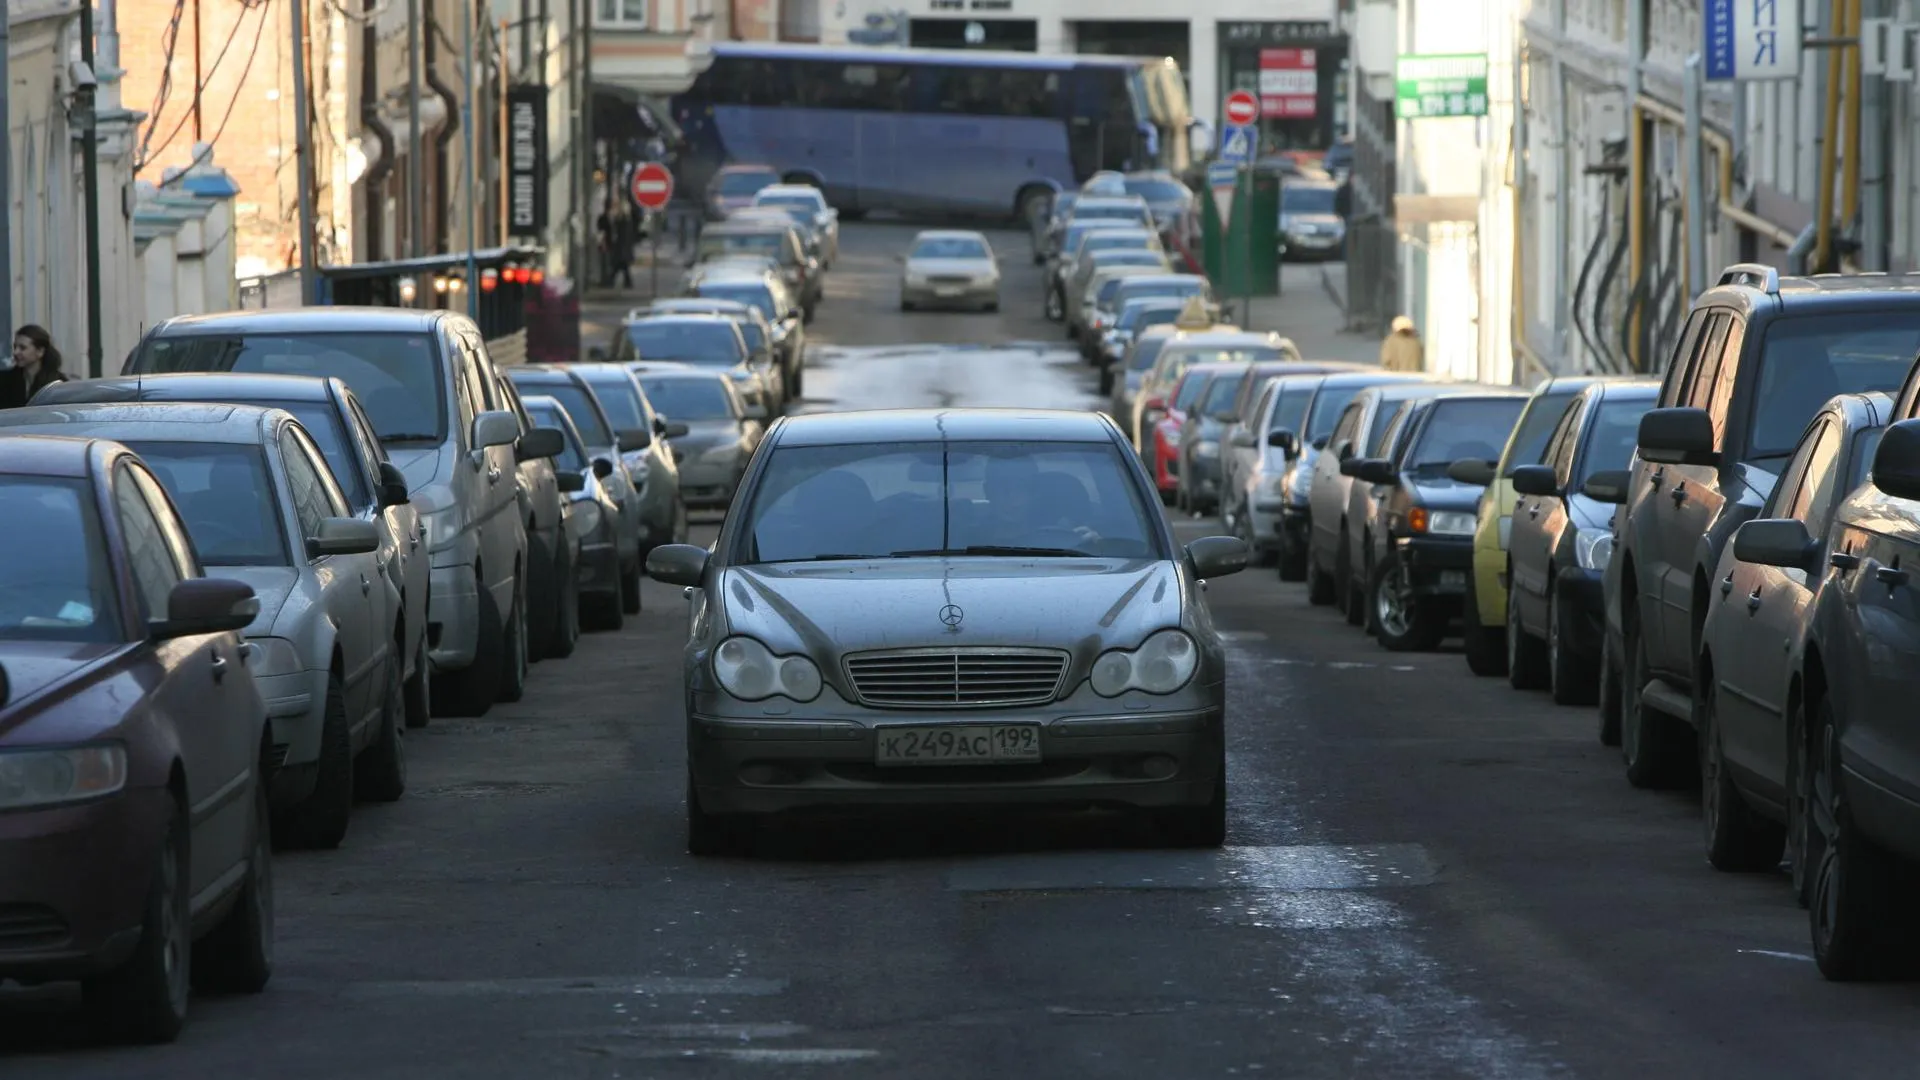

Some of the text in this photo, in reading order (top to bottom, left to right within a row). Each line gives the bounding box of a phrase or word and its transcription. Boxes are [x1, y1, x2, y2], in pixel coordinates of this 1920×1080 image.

[513, 174, 534, 226] САЛОН
[886, 728, 1033, 757] К249АС 199
